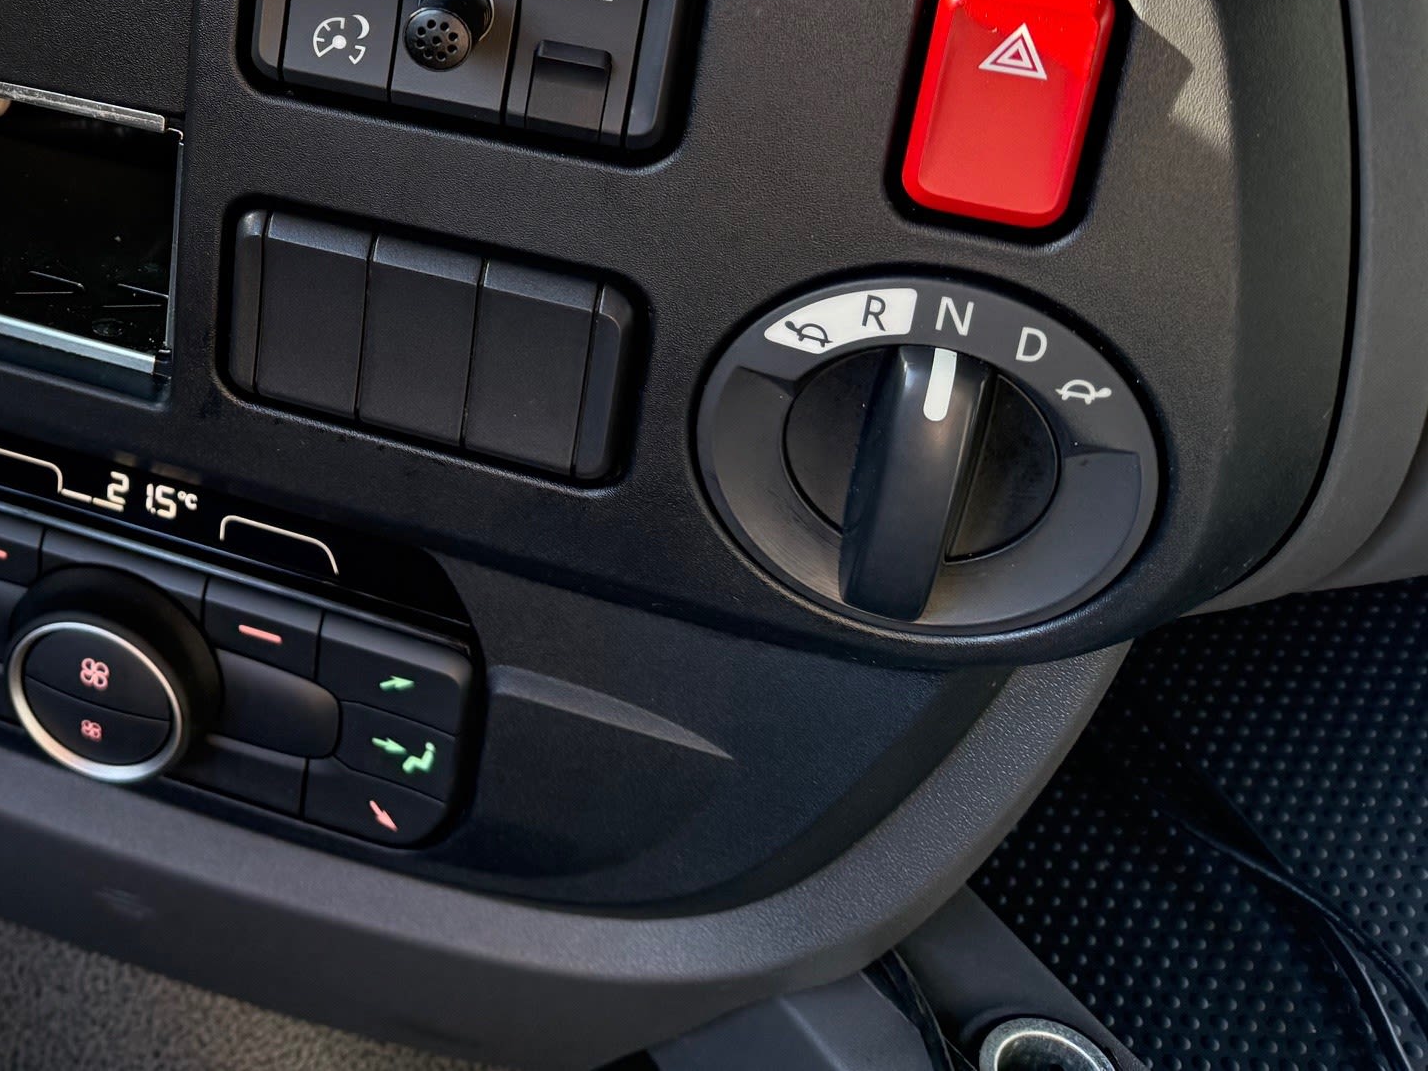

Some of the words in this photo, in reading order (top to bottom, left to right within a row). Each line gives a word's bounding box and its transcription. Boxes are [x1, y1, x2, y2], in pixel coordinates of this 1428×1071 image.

[862, 294, 886, 331] R
[935, 296, 975, 337] N
[1015, 326, 1048, 362] D
